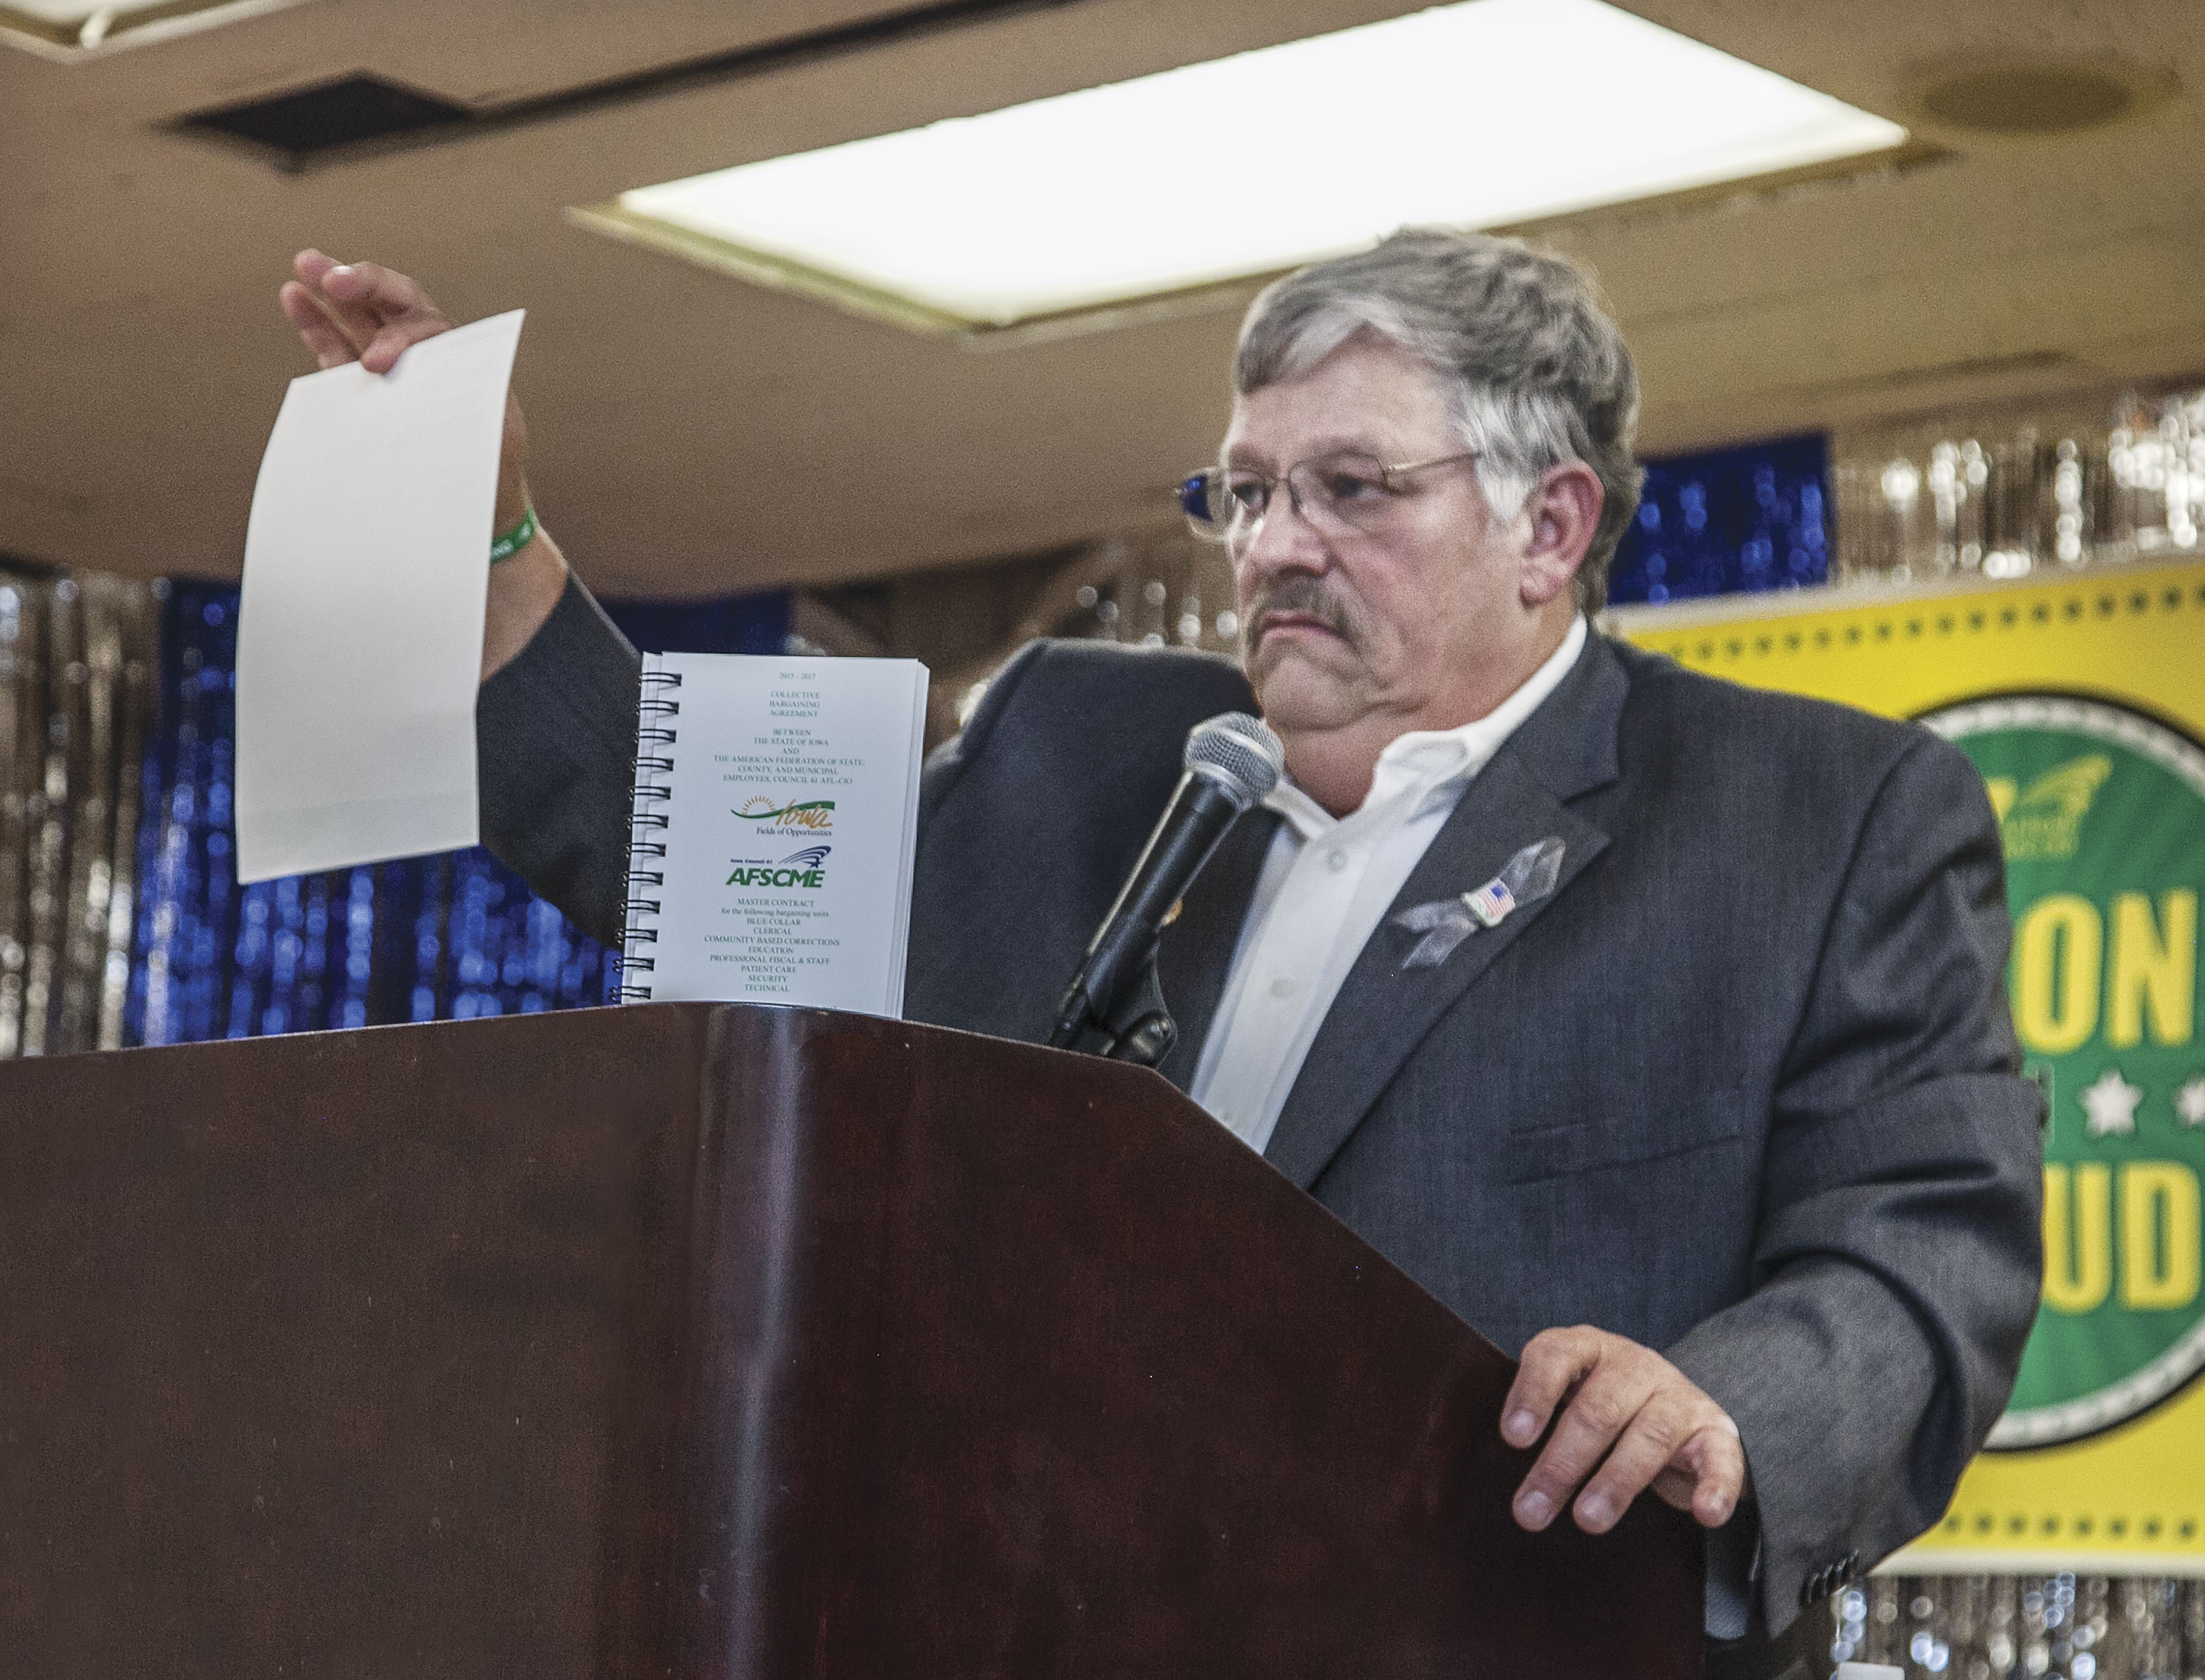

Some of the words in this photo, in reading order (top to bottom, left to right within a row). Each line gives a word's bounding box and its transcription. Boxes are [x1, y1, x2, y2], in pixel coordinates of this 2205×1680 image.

[776, 799, 833, 829] Iowa
[786, 828, 832, 838] Opportunities
[726, 867, 825, 888] AFSCME
[744, 908, 774, 917] following
[776, 909, 811, 917] bargaining
[710, 954, 767, 963] PROFESSIONAL
